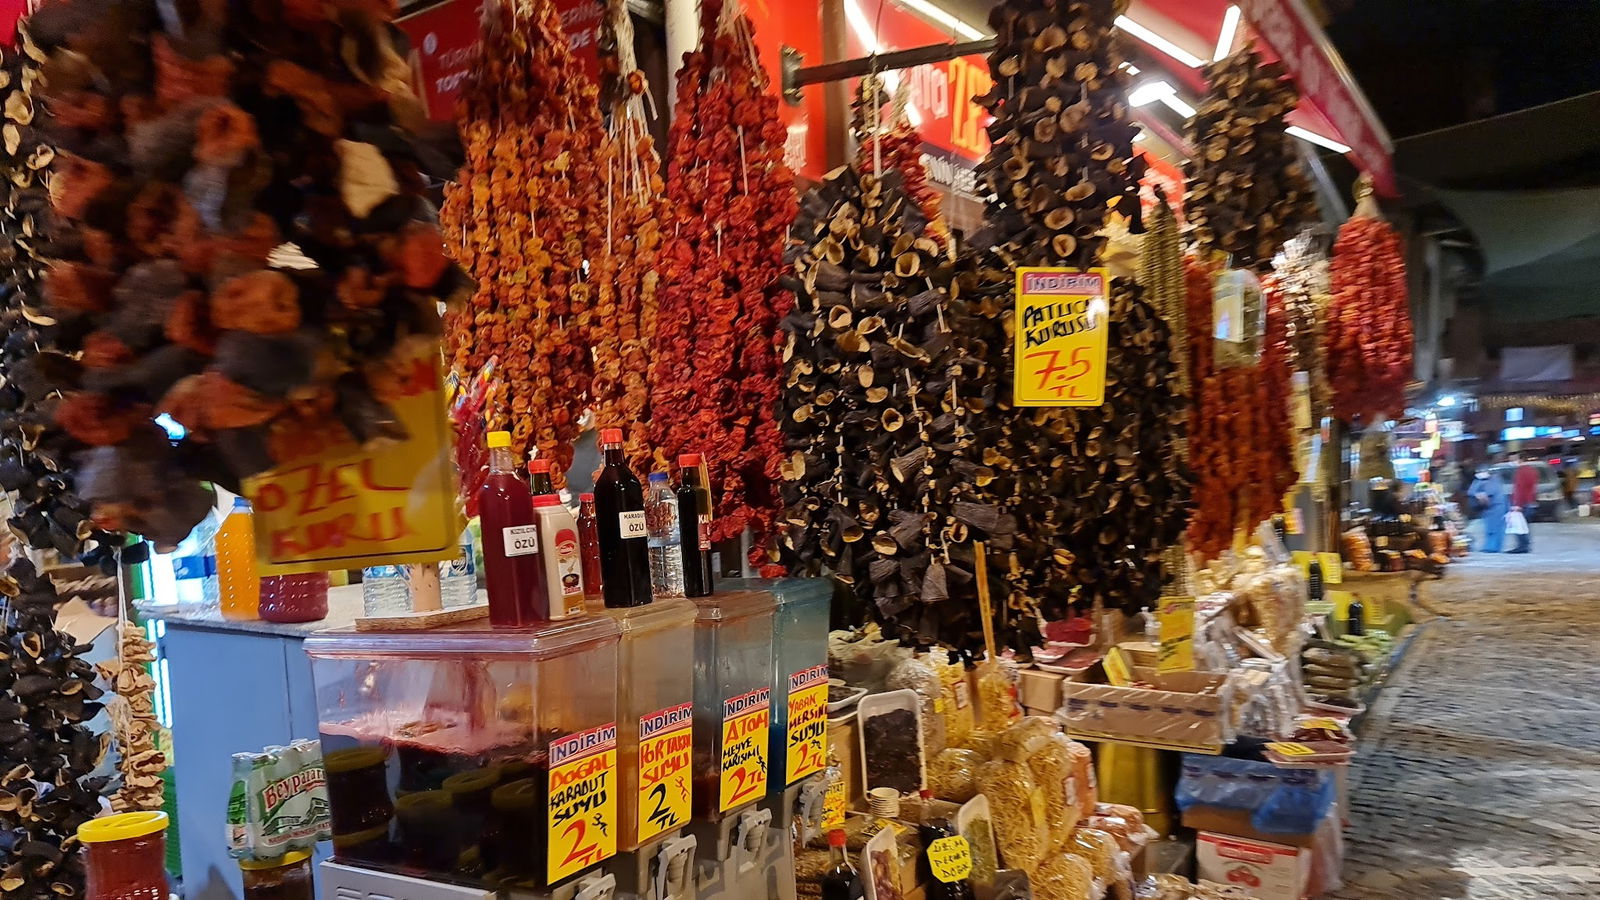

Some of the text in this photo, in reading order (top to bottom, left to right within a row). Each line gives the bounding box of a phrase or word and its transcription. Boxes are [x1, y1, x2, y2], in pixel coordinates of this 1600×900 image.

[1047, 384, 1089, 398] TL
[629, 521, 644, 532] ÖZÜ
[514, 537, 535, 549] ÖZÜ
[723, 690, 769, 718] İNDİRİM
[640, 707, 693, 738] İNDİRİM
[725, 711, 768, 745] ATOM
[789, 720, 825, 748] SUYU
[551, 727, 616, 764] İNDİRİM
[793, 743, 811, 776] 2
[809, 752, 826, 768] TL
[727, 766, 766, 806] 2 TL
[552, 789, 608, 828] SUYU
[647, 783, 671, 823] 2
[655, 811, 681, 831] TL
[558, 818, 599, 869] 2
[576, 848, 612, 867] TL
